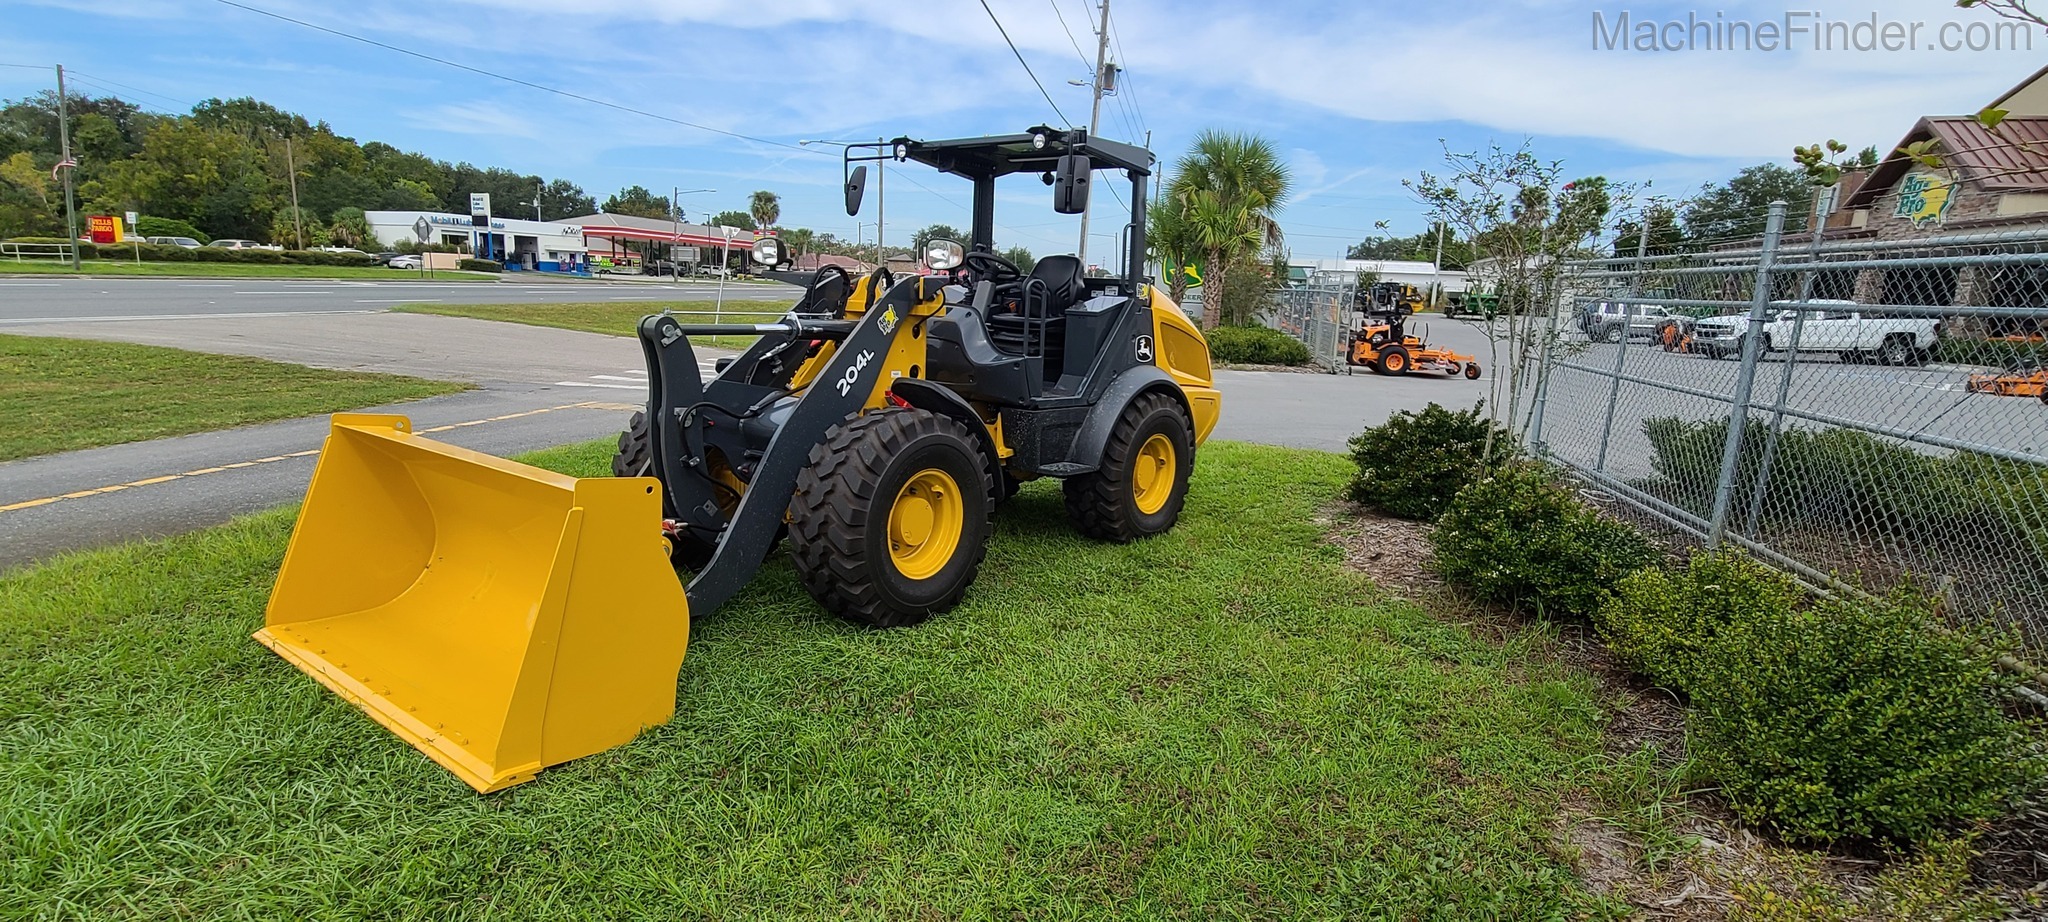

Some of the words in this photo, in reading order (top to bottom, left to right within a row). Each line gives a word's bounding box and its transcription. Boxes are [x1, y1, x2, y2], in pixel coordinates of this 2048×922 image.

[1896, 195, 1925, 215] Pro
[431, 216, 452, 224] Mobil
[1182, 293, 1204, 301] DEER
[836, 349, 875, 397] 204L
